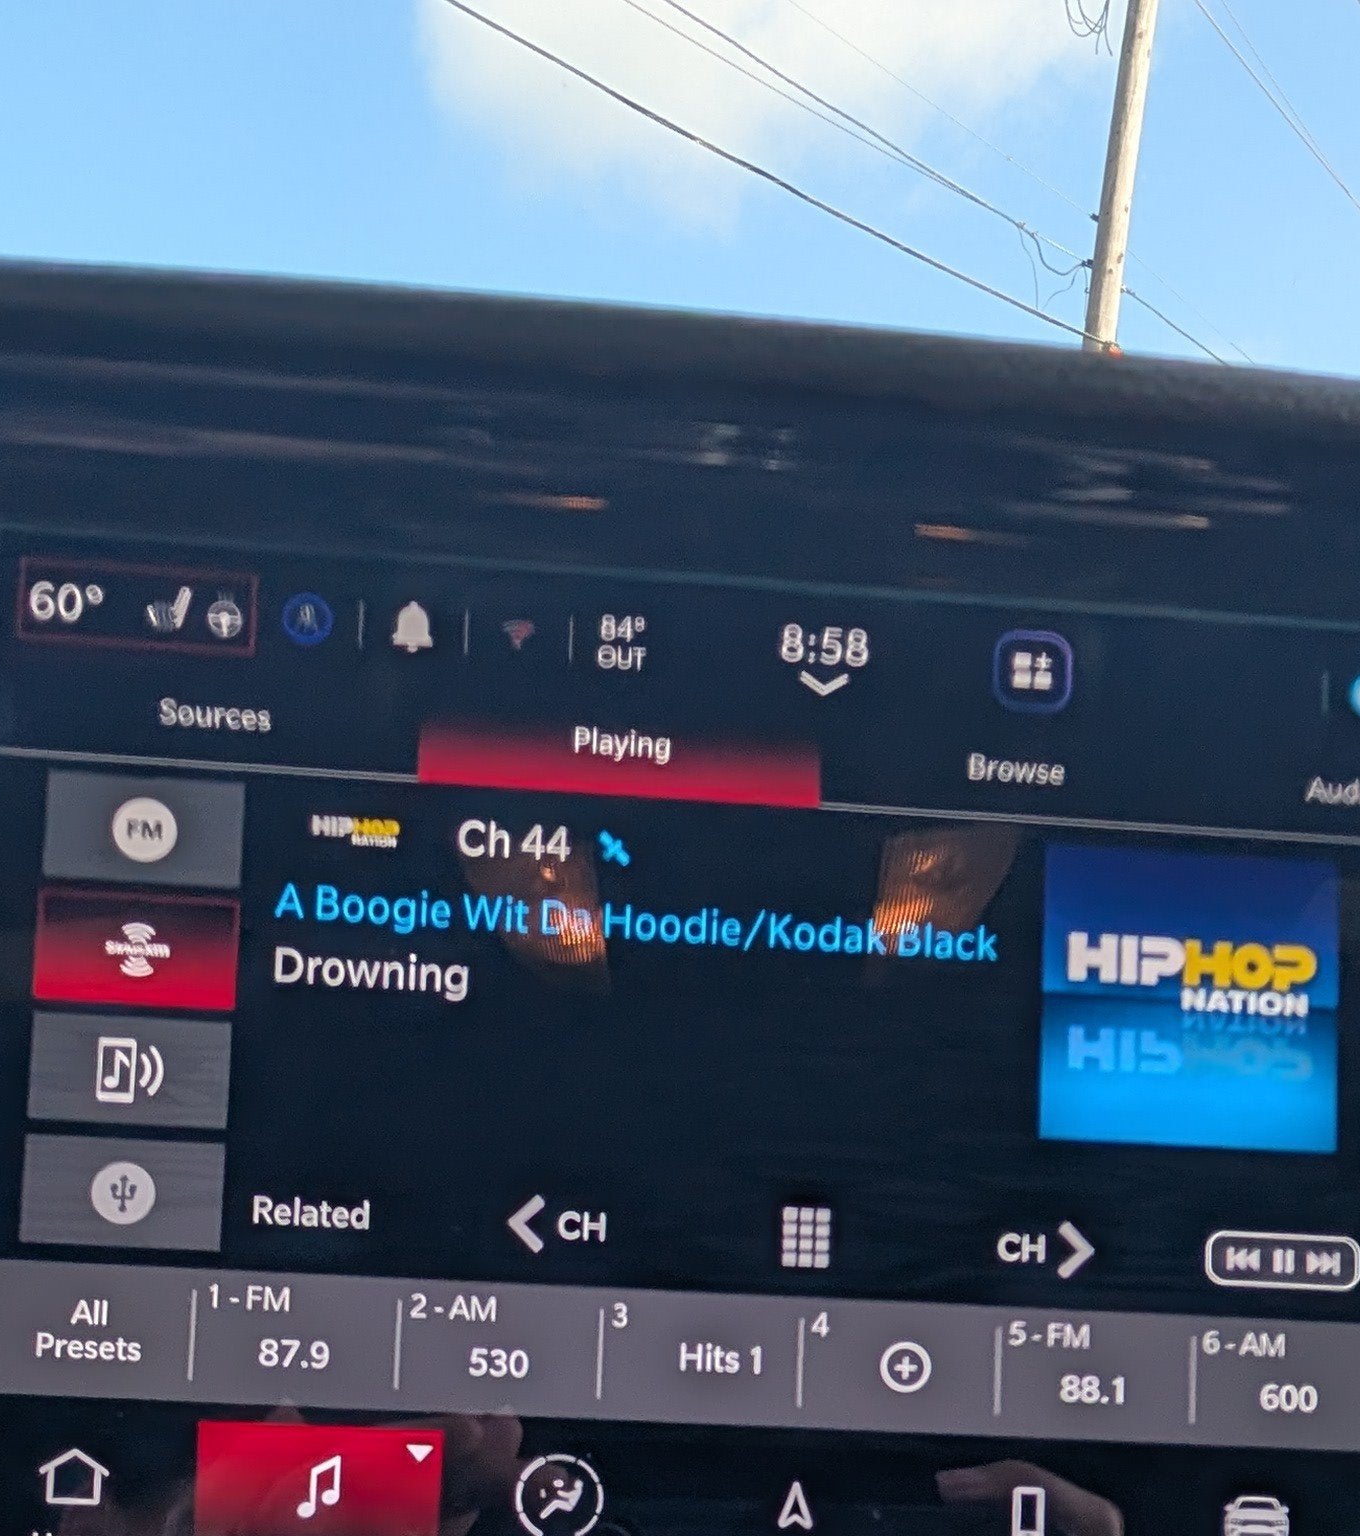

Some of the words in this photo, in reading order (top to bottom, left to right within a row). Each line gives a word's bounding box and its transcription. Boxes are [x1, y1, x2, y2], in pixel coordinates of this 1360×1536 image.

[597, 644, 647, 671] OUT
[780, 622, 870, 667] 8:58
[159, 697, 272, 732] Sources
[574, 725, 671, 765] Playing
[966, 752, 1066, 787] Browse
[126, 818, 164, 841] FM
[457, 819, 511, 859] Ch
[520, 824, 572, 863] 44
[274, 882, 304, 919] A
[316, 884, 451, 935] Boogie
[463, 893, 529, 935] Wit
[541, 898, 593, 938] Da
[603, 902, 888, 956] Hoodie/Kodak
[897, 924, 999, 963] Black
[273, 946, 470, 1002] Drowning
[1180, 988, 1309, 1020] NATION
[251, 1195, 371, 1232] Related
[557, 1211, 607, 1243] CH
[996, 1232, 1046, 1264] CH
[70, 1299, 108, 1327] All
[612, 1304, 629, 1329] 3
[811, 1312, 830, 1338] 4
[34, 1332, 142, 1367] Presets
[258, 1338, 331, 1371] 87.9
[468, 1347, 530, 1379] 530
[678, 1341, 740, 1375] Hits
[750, 1345, 763, 1376] 1
[1059, 1374, 1126, 1405] 88.1
[1259, 1383, 1319, 1414] 600
